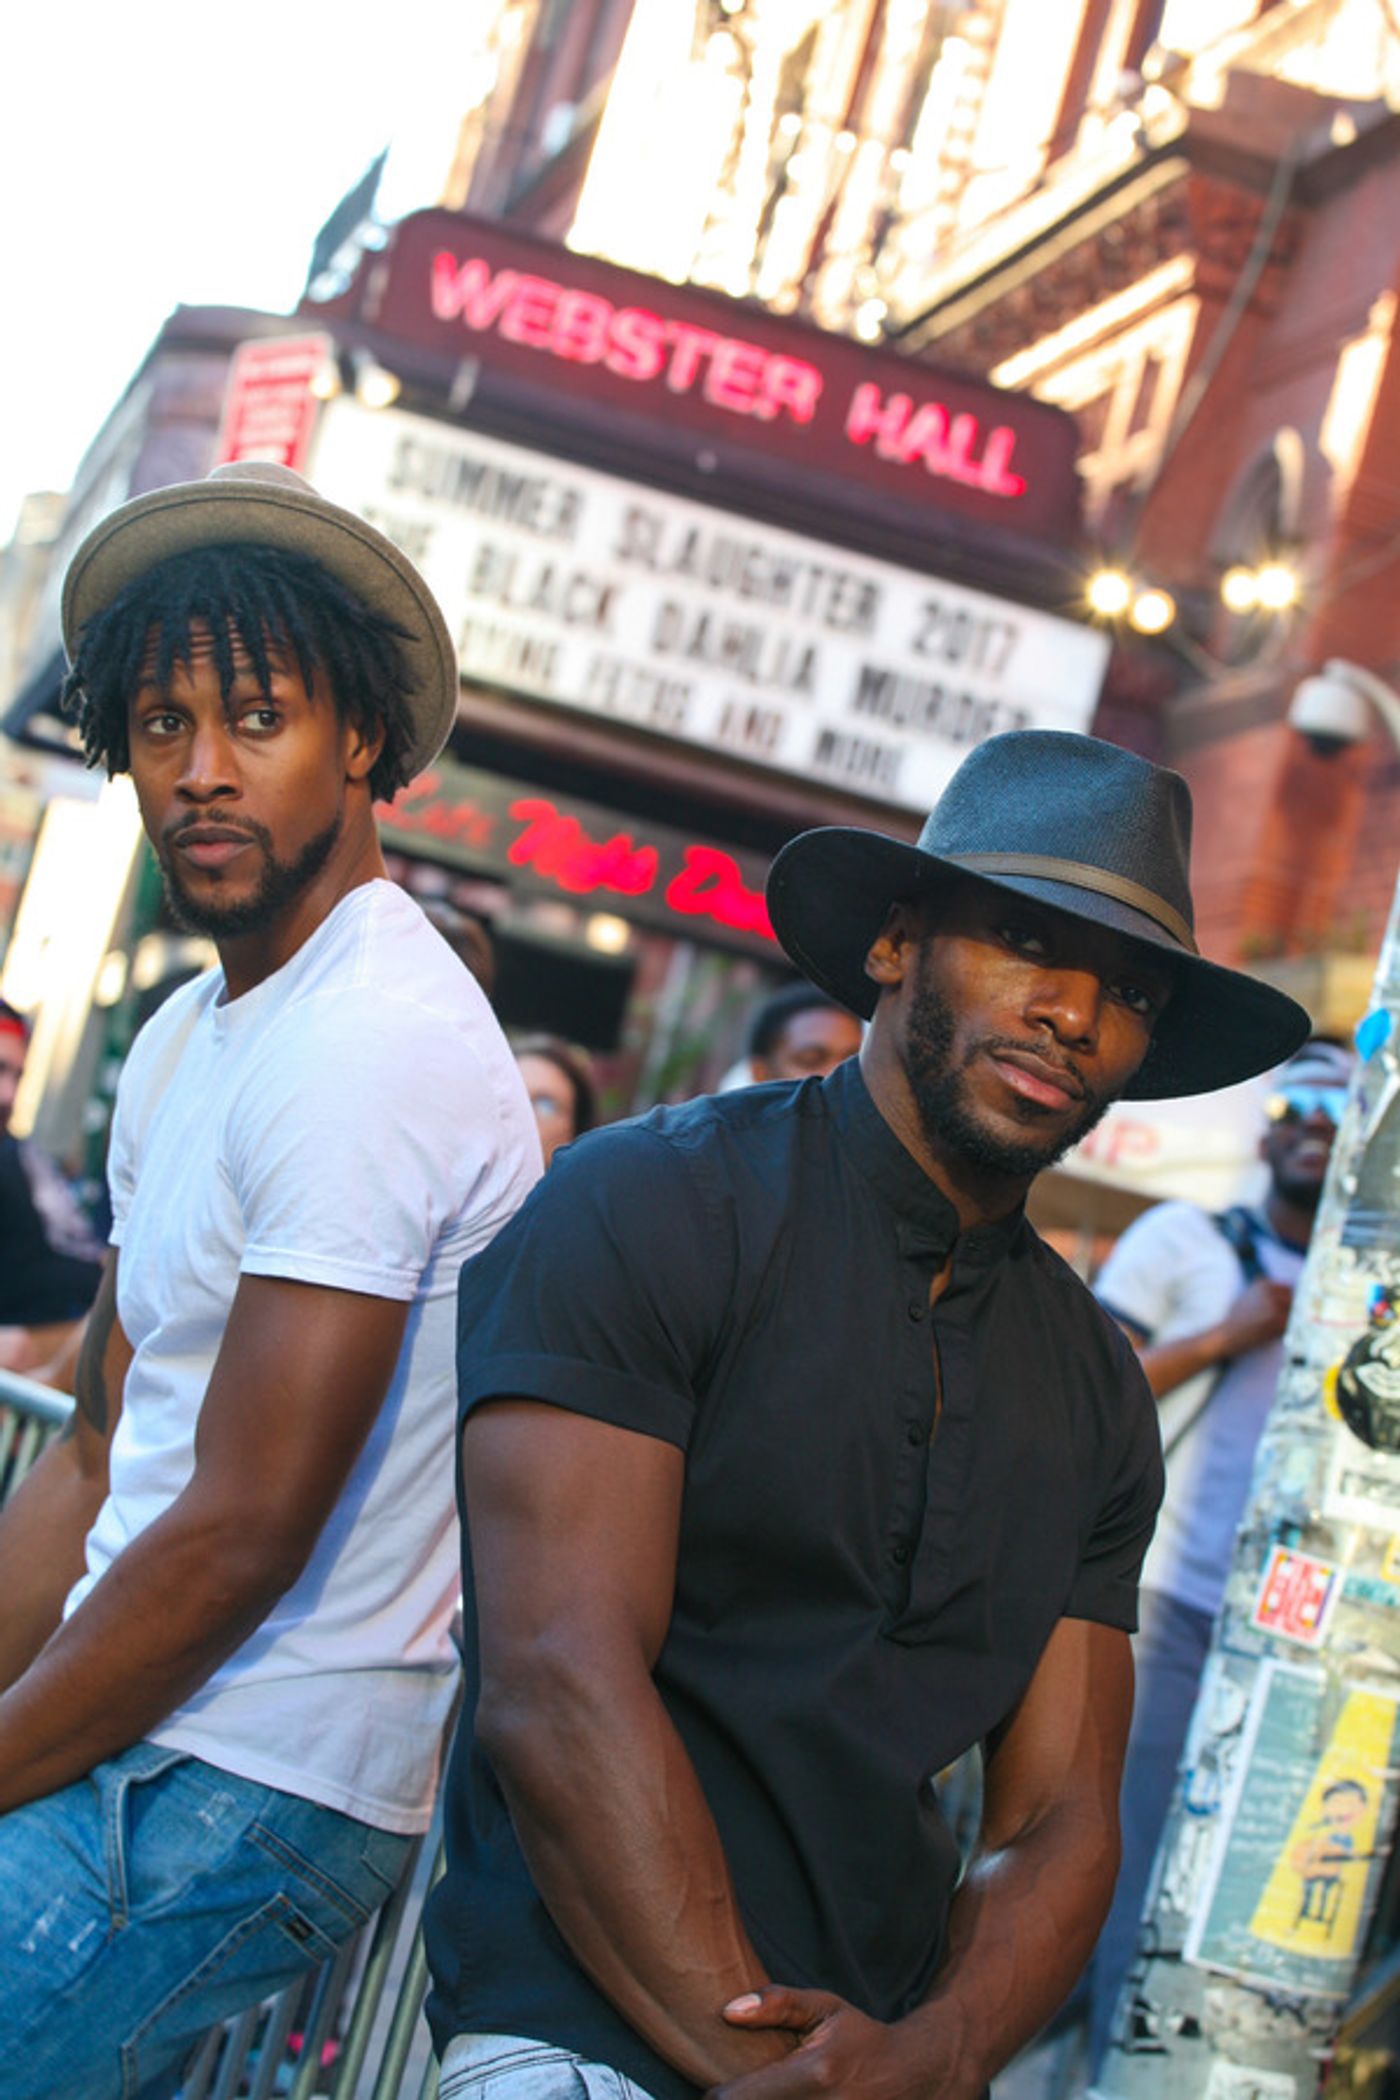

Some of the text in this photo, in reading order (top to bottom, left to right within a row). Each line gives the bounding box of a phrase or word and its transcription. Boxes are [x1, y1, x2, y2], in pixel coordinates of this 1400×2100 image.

[430, 250, 825, 425] WEBSTER
[845, 382, 1028, 498] HALL
[388, 435, 1018, 674] SUMMER SLAUGHTER 2017
[468, 541, 622, 634] BLACK
[652, 600, 816, 694] DAHLIA
[718, 700, 784, 752] AND
[814, 726, 903, 786] MORE
